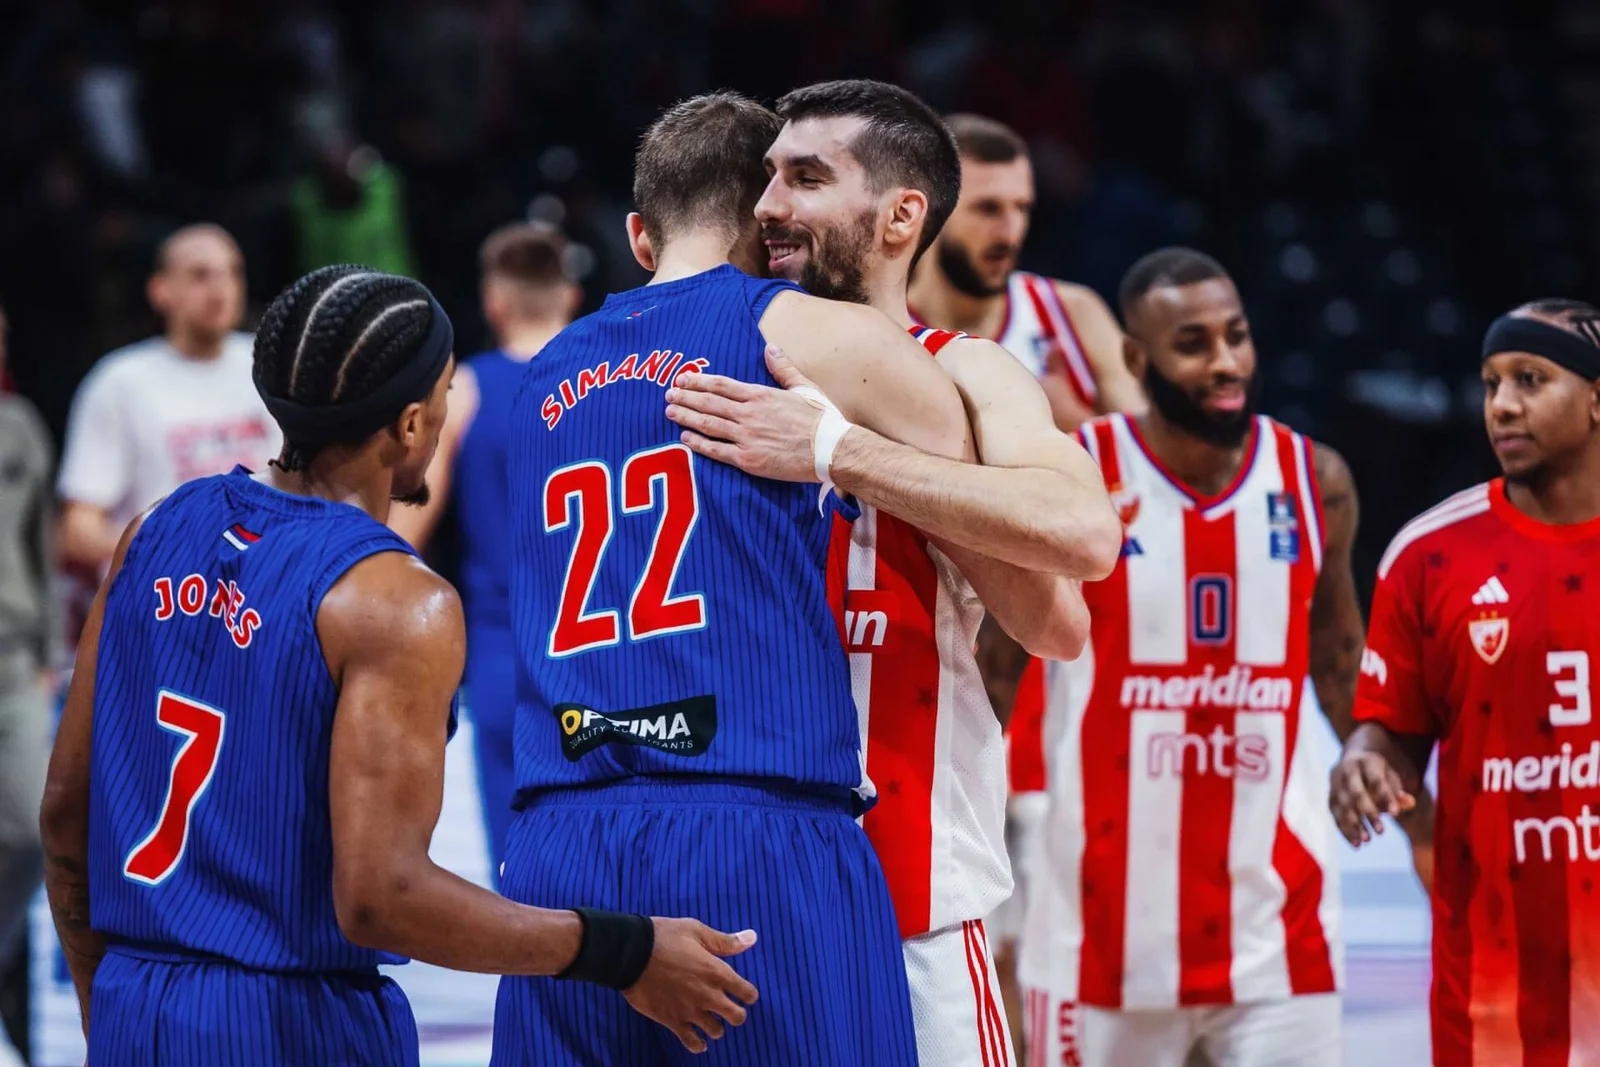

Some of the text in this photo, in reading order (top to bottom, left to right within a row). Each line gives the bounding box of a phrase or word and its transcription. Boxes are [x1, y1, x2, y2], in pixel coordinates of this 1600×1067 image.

[544, 443, 706, 657] 22
[154, 573, 261, 648] JONES
[1190, 575, 1230, 642] 0
[1120, 665, 1292, 711] meridian
[1546, 650, 1591, 727] 3
[124, 689, 225, 885] 7
[1147, 724, 1270, 782] mts
